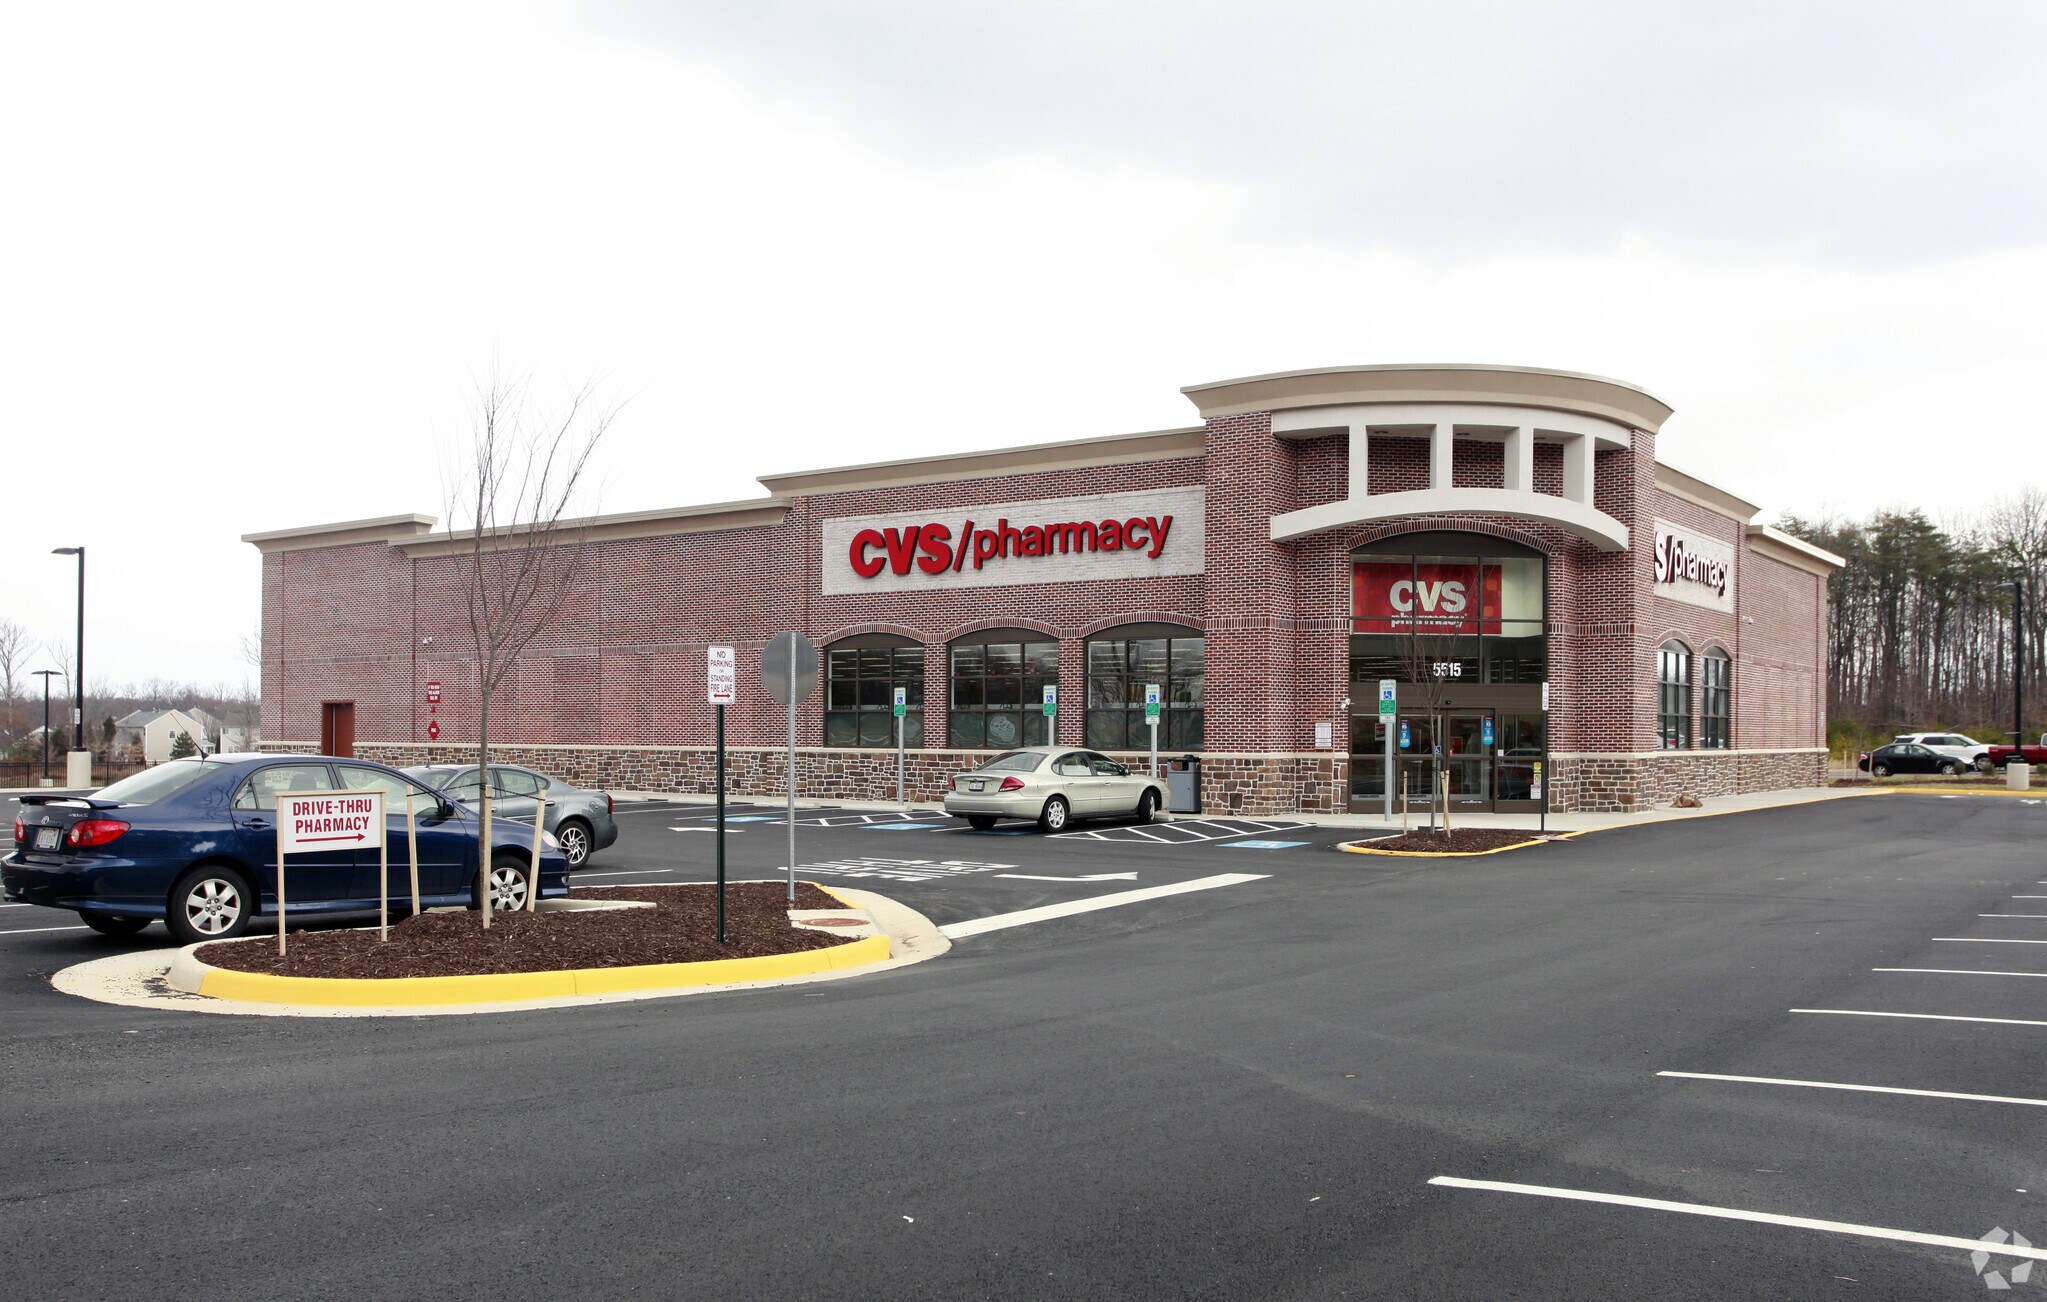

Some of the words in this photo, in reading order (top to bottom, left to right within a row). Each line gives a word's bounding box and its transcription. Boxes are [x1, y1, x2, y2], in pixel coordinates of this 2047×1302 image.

[849, 515, 1174, 578] CVS/pharmacy
[1389, 579, 1467, 613] CVS
[710, 660, 733, 668] PARKING
[1433, 662, 1462, 677] 5515
[710, 684, 720, 692] FIRE
[721, 684, 733, 692] LANE
[292, 799, 372, 816] DRIVE-THRU
[295, 816, 370, 834] PHARMACY
